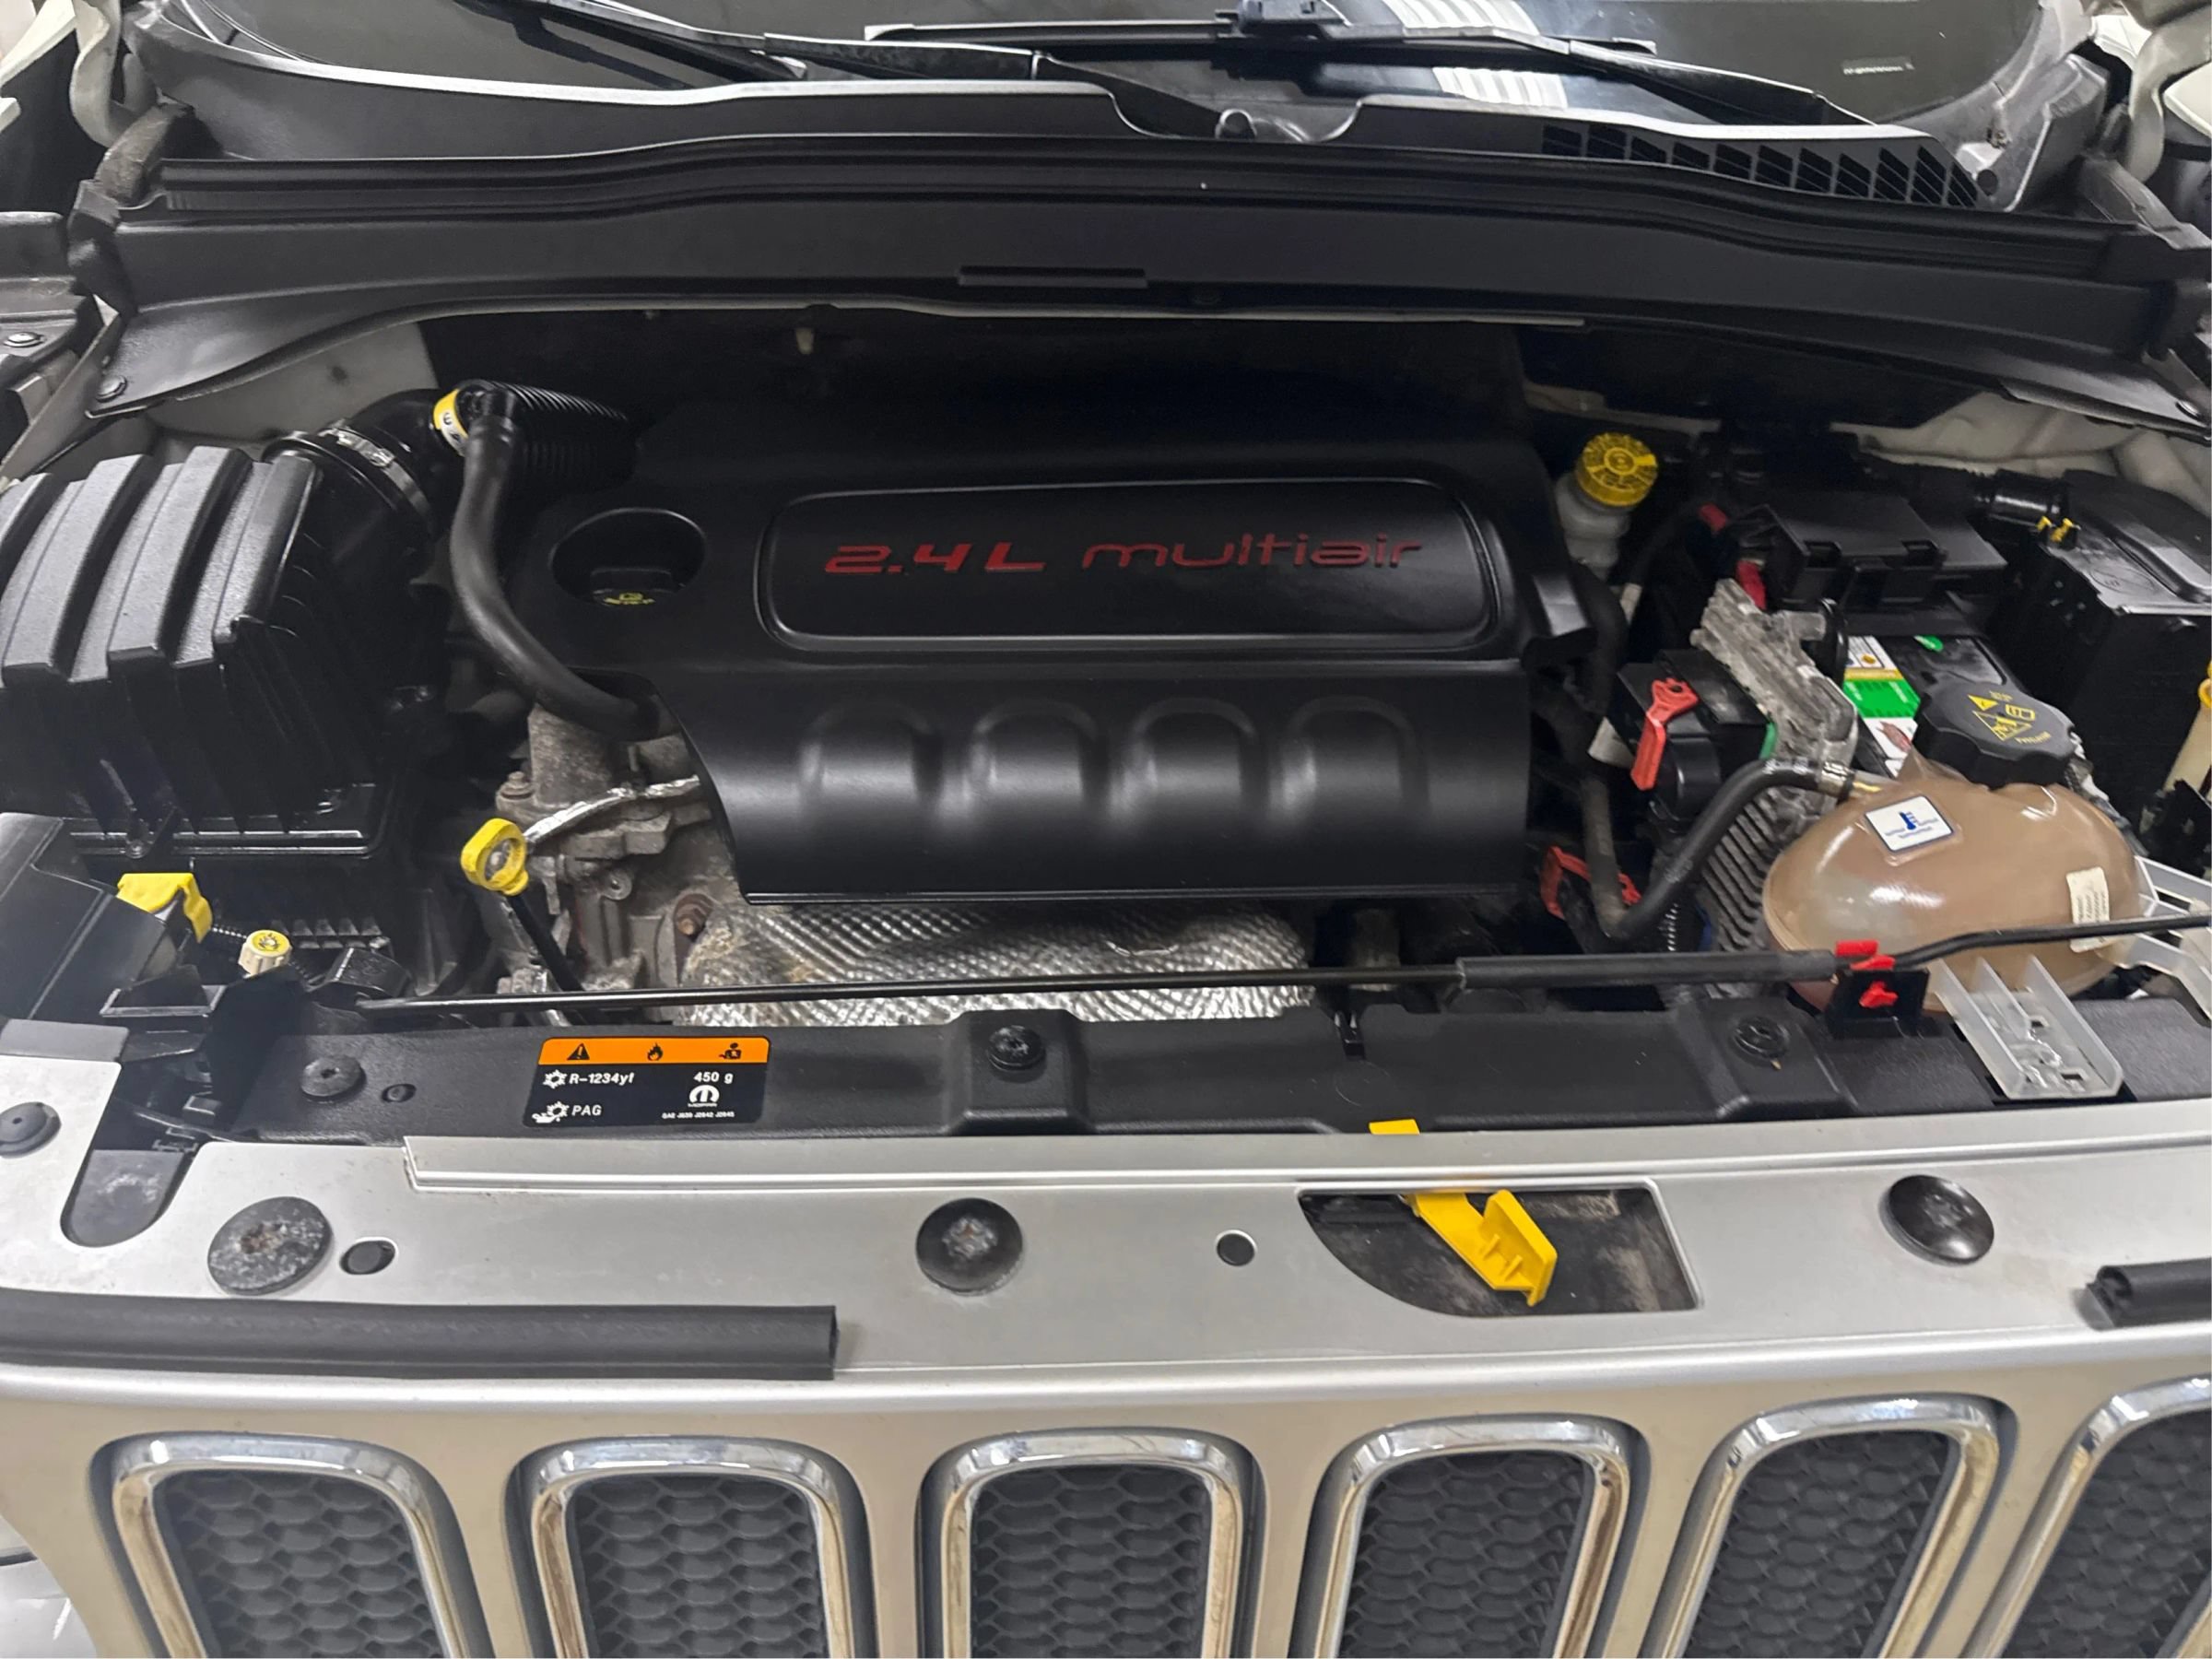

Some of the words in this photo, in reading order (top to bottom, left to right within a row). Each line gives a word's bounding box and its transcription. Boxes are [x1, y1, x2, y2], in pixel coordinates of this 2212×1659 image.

[1081, 532, 1422, 570] multiair
[693, 1071, 720, 1083] 450
[724, 1073, 735, 1085] g
[571, 1104, 602, 1116] PAG
